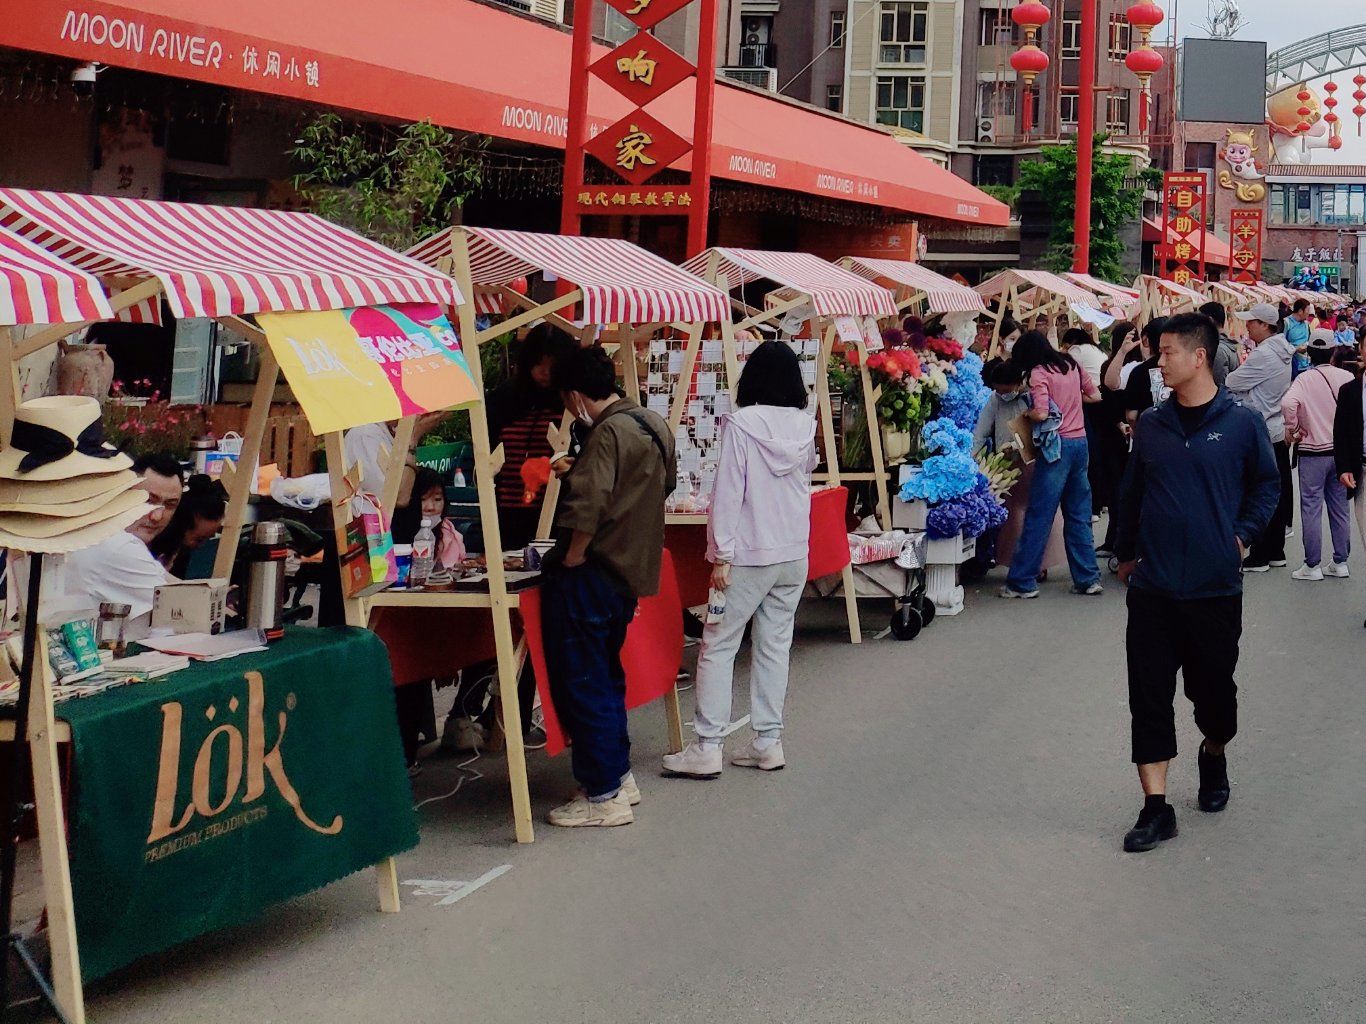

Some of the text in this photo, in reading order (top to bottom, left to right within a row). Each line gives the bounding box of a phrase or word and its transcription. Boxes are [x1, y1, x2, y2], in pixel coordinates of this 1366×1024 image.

[60, 10, 145, 54] MOON
[149, 28, 223, 69] RIVER
[502, 105, 542, 132] MOON
[543, 114, 568, 137] RIVE
[729, 155, 777, 179] MOON RIVER
[1174, 190, 1193, 284] 自助烤肉
